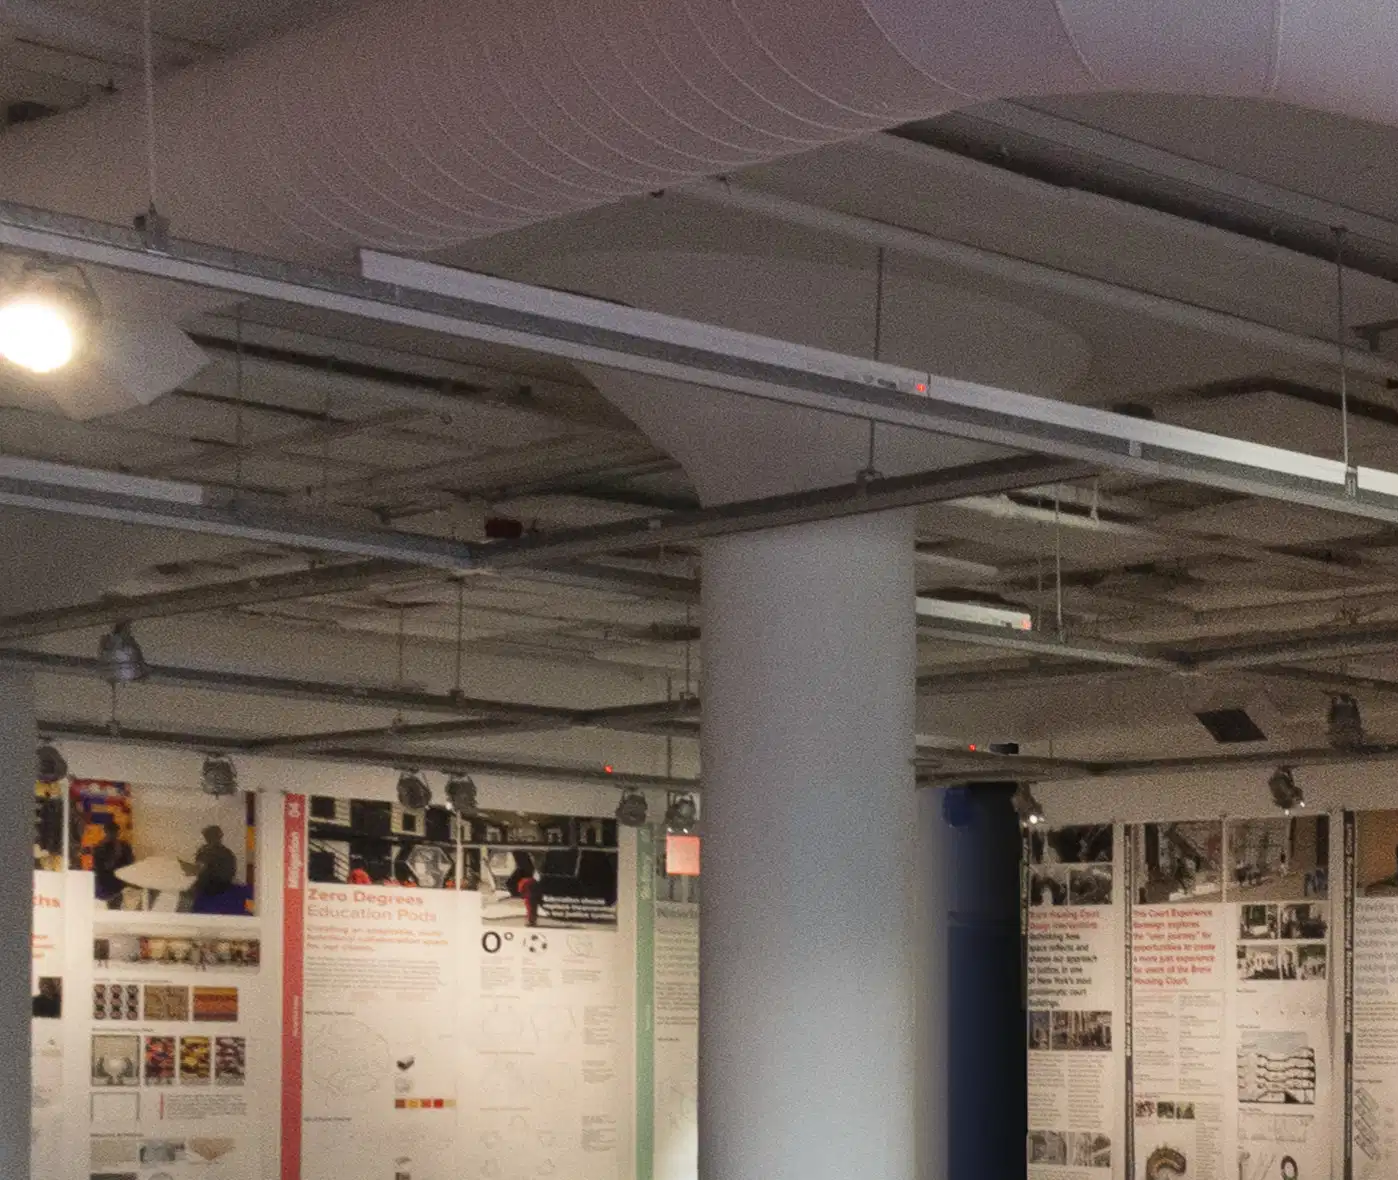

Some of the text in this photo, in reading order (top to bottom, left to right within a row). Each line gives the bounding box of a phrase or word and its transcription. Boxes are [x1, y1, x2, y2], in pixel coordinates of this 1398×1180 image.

[308, 888, 423, 905] Zero Degrees
[308, 904, 436, 922] Education Pods
